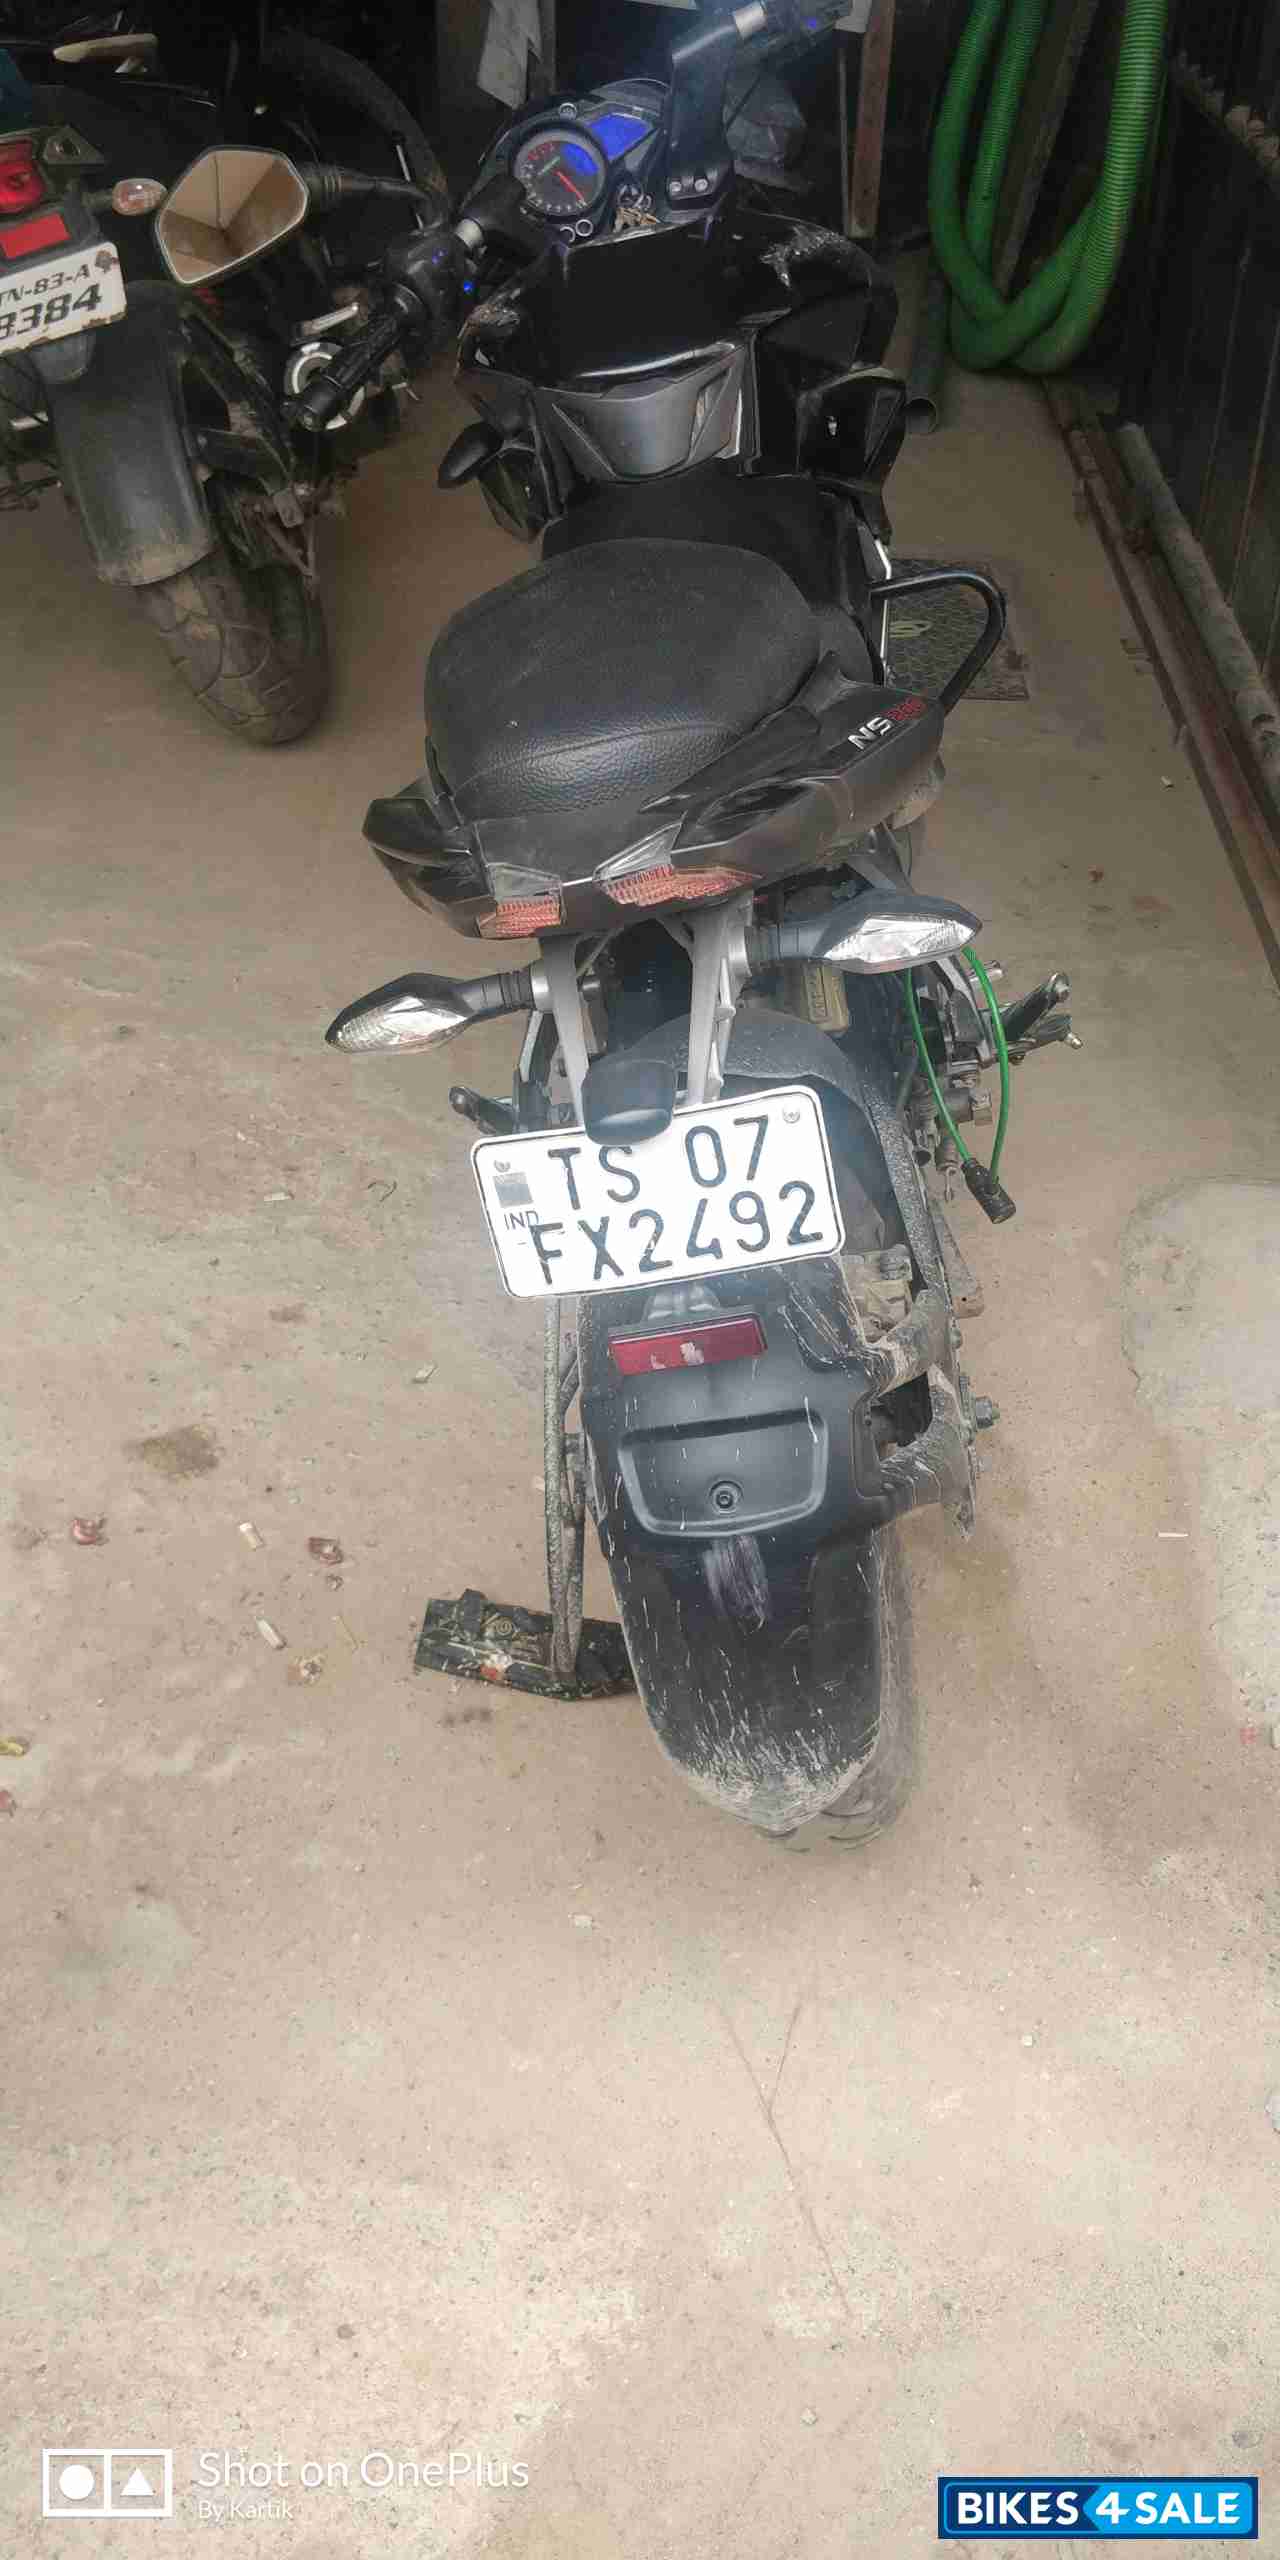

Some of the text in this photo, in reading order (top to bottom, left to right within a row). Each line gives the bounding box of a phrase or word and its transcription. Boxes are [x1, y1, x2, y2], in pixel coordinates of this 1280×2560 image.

[548, 1115, 769, 1210] TS 07
[504, 1210, 540, 1231] IND
[529, 1180, 823, 1285] FX2492
